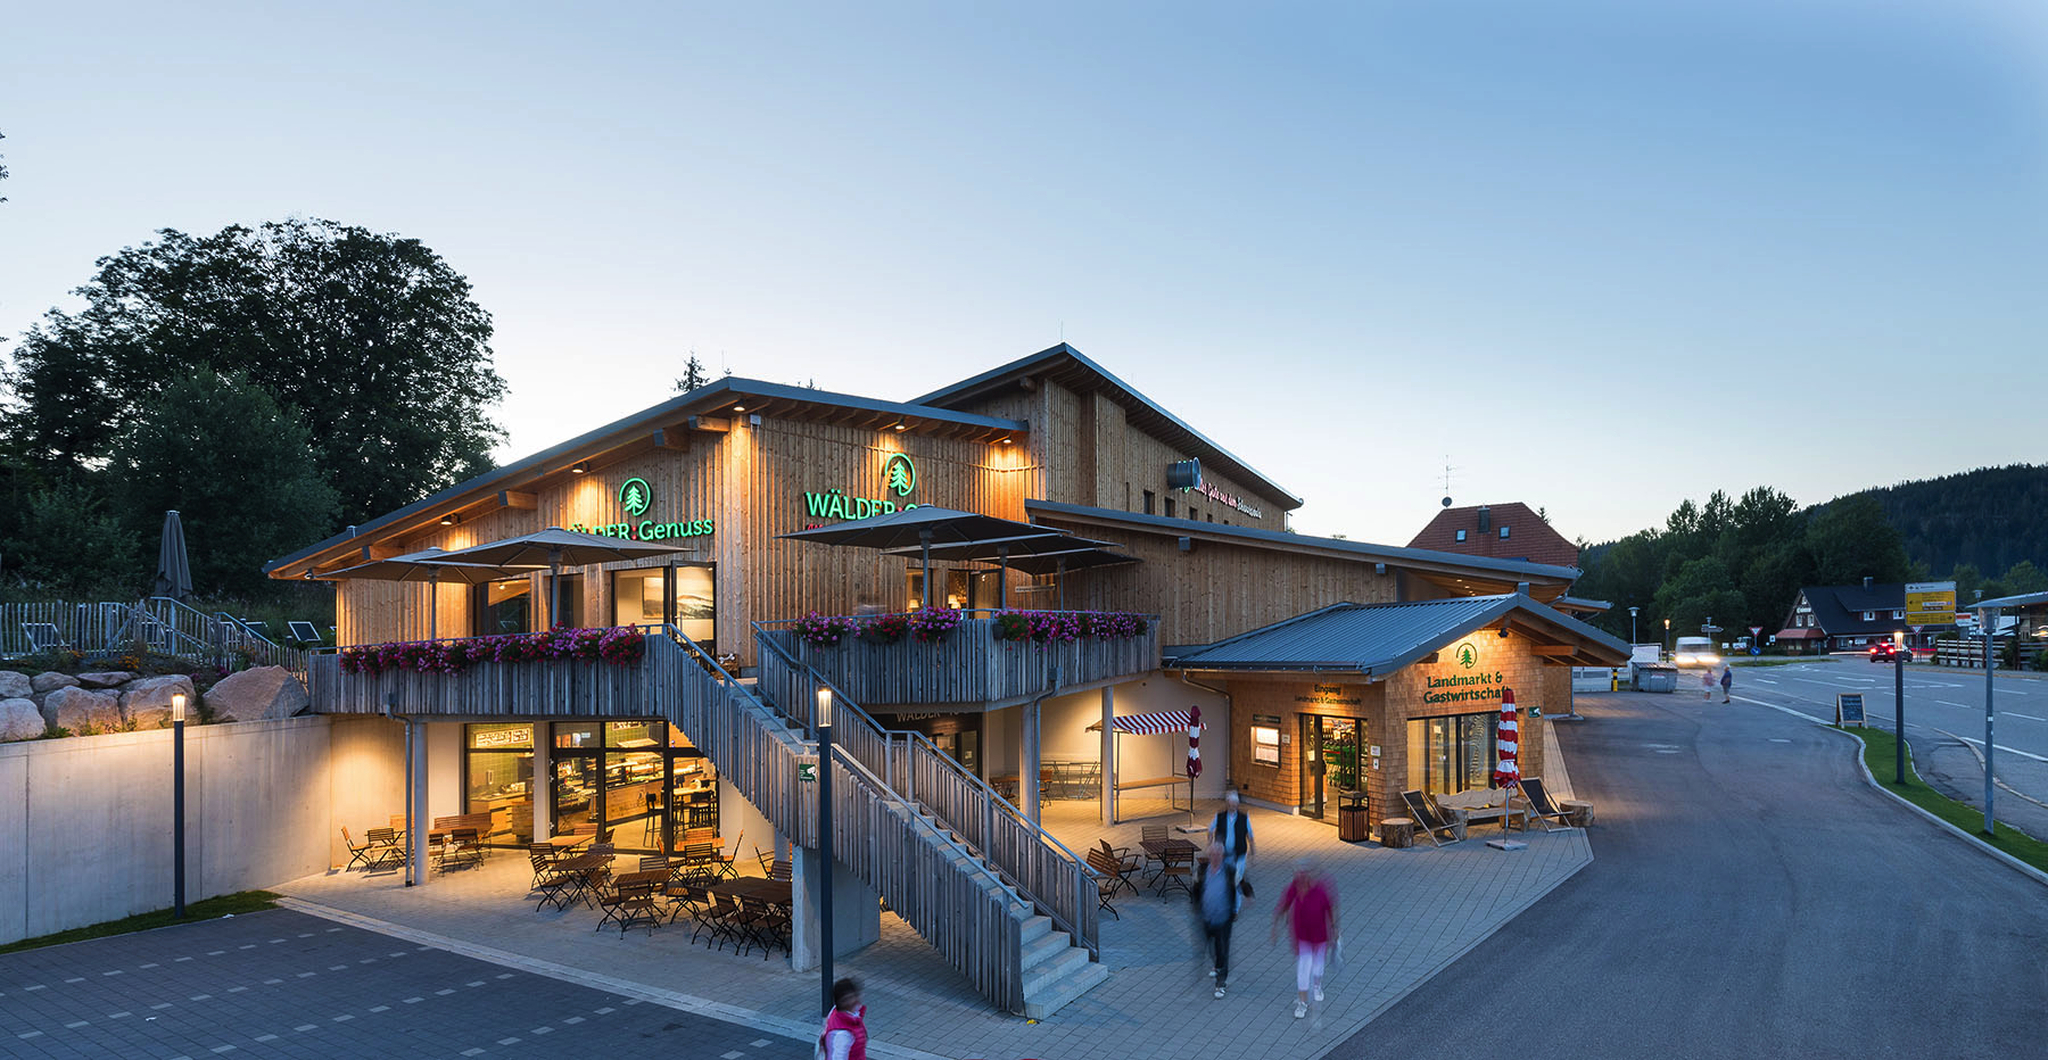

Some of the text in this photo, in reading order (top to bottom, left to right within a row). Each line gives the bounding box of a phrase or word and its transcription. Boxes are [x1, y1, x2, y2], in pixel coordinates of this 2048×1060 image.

[1427, 671, 1503, 688] Landmarkt &
[1314, 684, 1341, 695] Eingang
[1423, 685, 1511, 704] Gastwirtschaf
